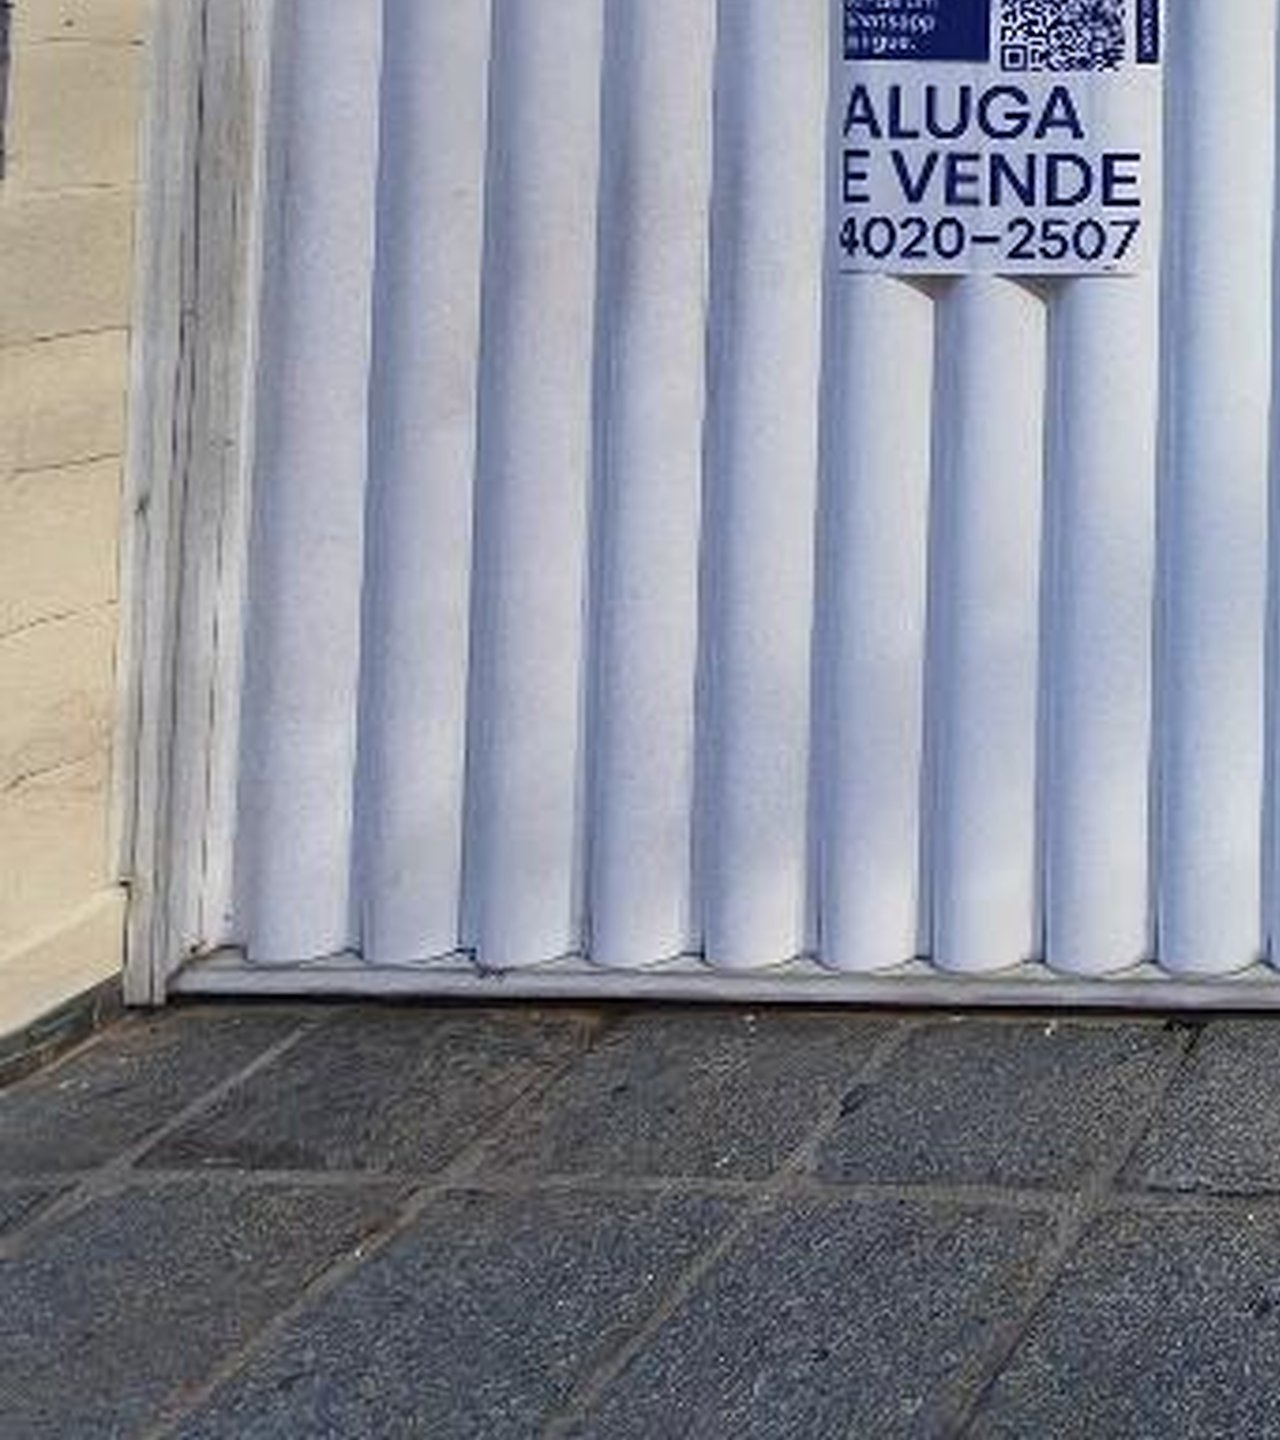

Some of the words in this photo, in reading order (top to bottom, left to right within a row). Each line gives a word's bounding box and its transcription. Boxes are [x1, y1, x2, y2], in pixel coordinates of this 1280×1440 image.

[843, 84, 1085, 140] ALUGA
[842, 150, 870, 203] E
[892, 152, 1141, 207] VENDE
[839, 216, 1141, 260] 4020-2507
